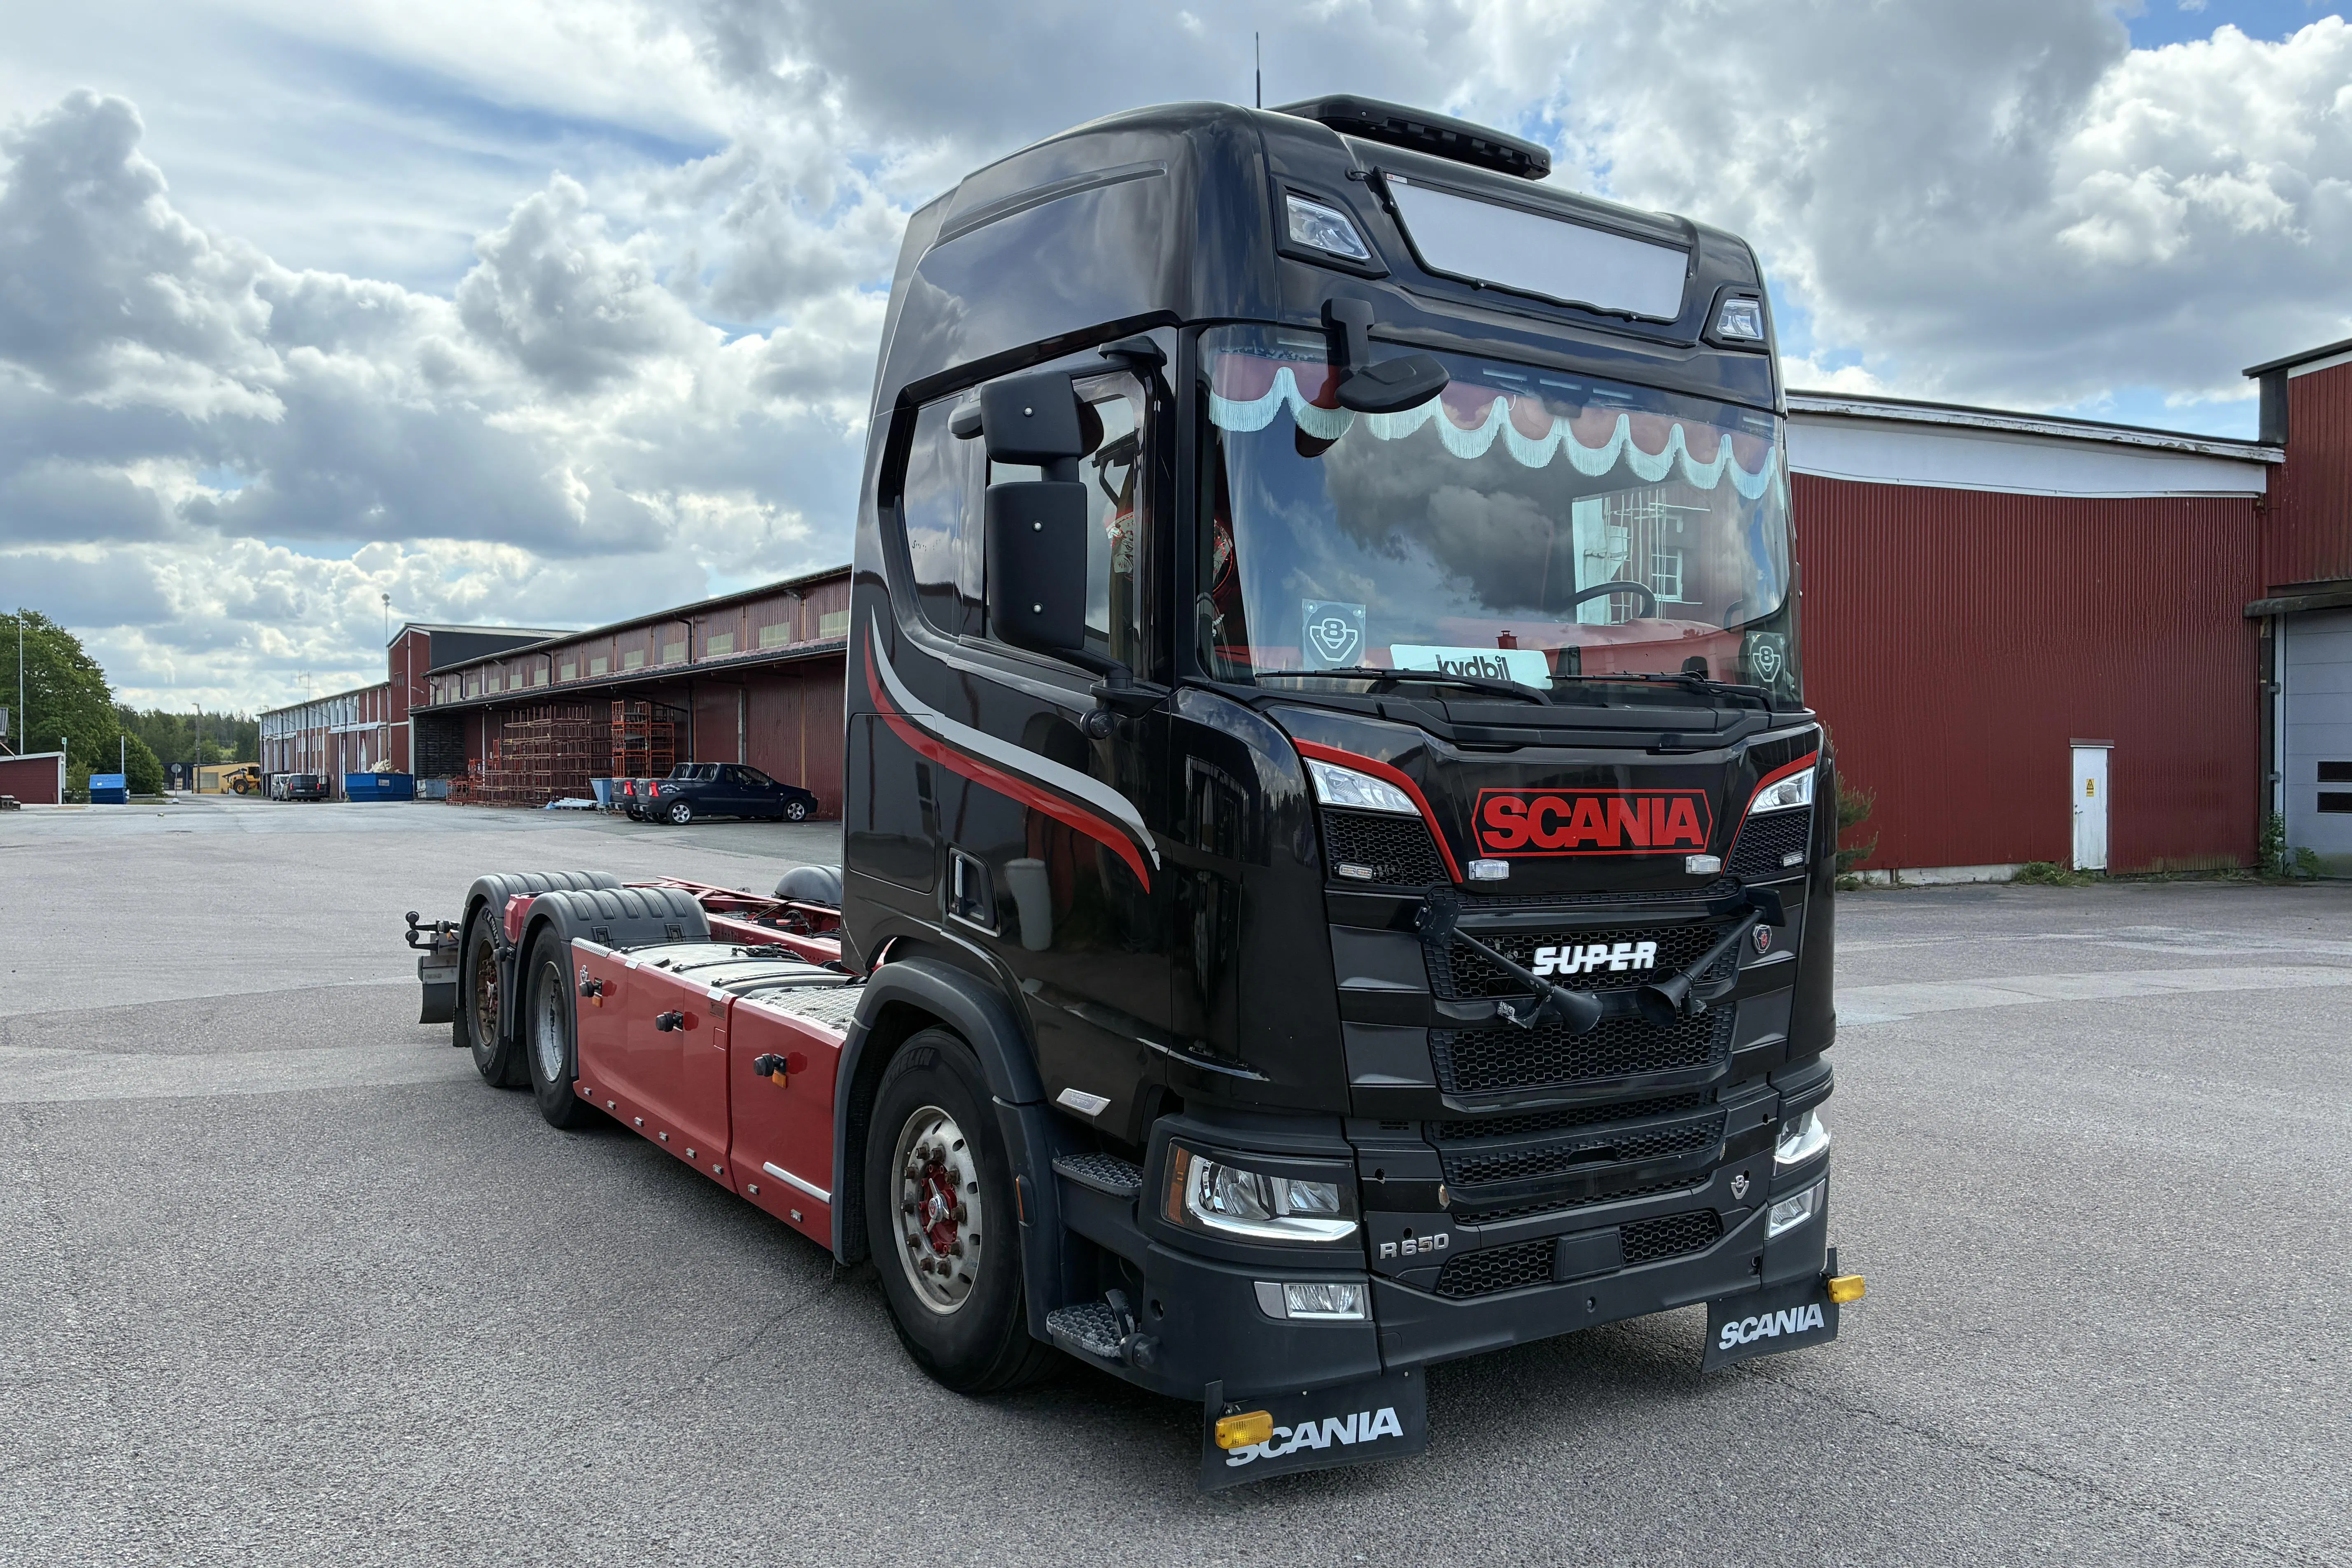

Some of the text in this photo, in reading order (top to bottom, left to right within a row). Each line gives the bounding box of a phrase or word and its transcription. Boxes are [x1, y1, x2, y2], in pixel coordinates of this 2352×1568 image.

[1483, 796, 1703, 849] SCANIA
[1532, 942, 1657, 975] SUPER
[1380, 1233, 1449, 1259] R 650
[1719, 1303, 1825, 1350] SCANIA
